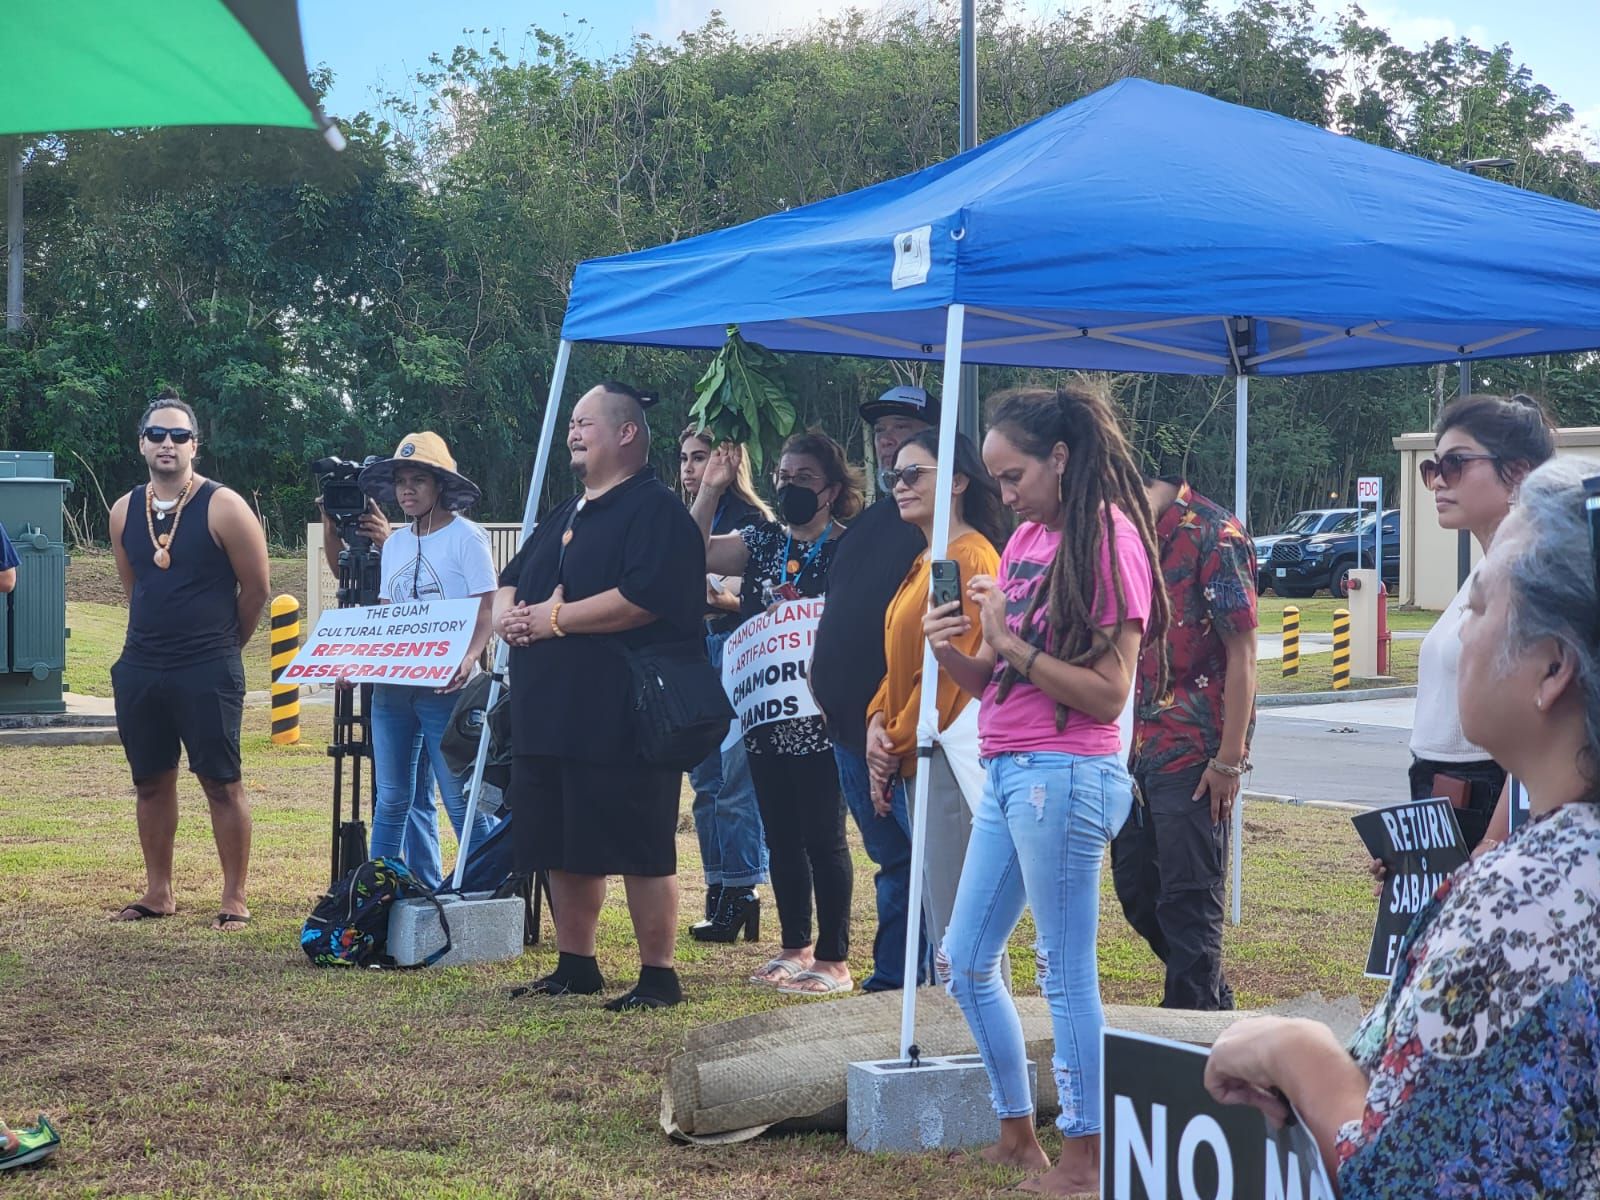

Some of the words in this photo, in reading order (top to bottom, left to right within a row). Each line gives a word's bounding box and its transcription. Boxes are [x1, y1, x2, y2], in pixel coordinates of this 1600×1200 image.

[1358, 481, 1378, 497] FDC
[366, 607, 390, 619] THE
[391, 604, 430, 618] GUAM
[317, 626, 383, 637] CULTURAL
[386, 620, 468, 636] REPOSITORY
[311, 640, 451, 657] REPRESENTS
[736, 632, 801, 674] ARTIFACTS
[286, 664, 453, 680] DESECRATION!
[740, 695, 799, 734] HANDS
[1380, 803, 1456, 852] RETURN
[1114, 1095, 1234, 1200] NO
